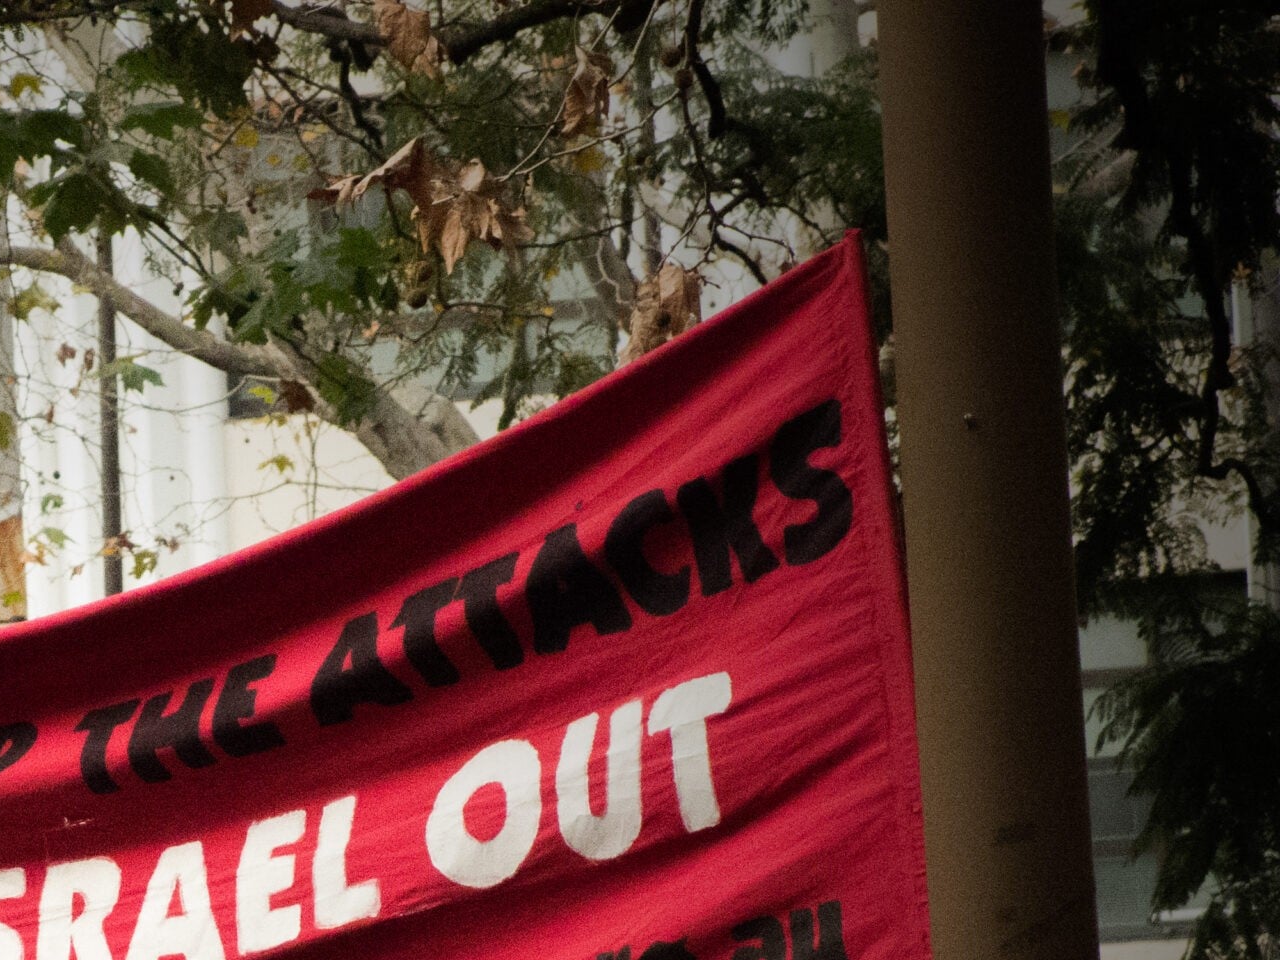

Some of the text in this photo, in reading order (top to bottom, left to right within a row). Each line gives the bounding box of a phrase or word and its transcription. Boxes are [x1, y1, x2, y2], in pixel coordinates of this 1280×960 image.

[75, 653, 287, 795] THE
[309, 399, 854, 725] ATTACKS
[426, 671, 733, 889] OUT
